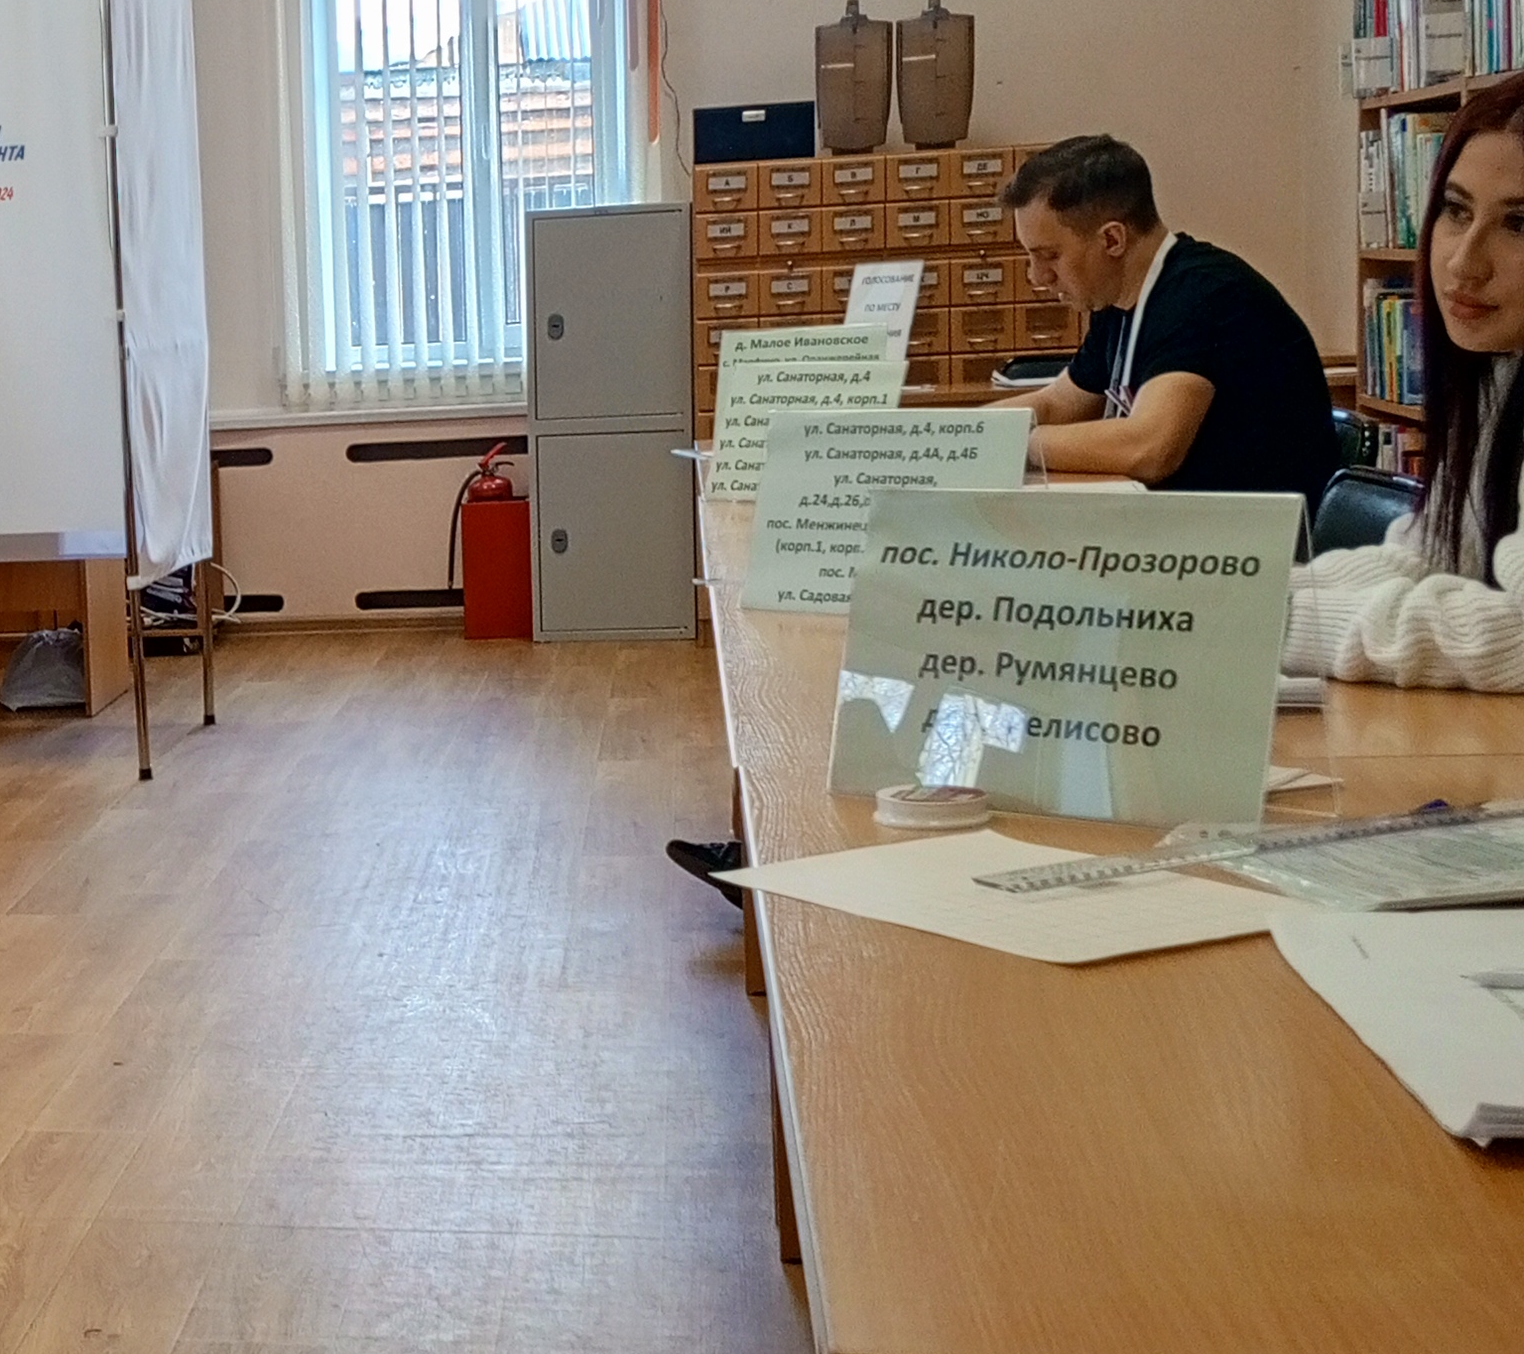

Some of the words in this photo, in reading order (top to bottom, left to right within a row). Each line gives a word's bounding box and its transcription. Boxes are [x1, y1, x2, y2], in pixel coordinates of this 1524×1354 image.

[861, 274, 915, 285] ГОЛОСОВАНИЕ
[864, 303, 876, 312] ПО
[877, 302, 901, 312] МЕСТУ
[735, 342, 747, 352] д.
[750, 339, 791, 349] Малое
[794, 336, 869, 347] Ивановское
[757, 373, 773, 385] ул.
[776, 371, 847, 384] Санаторная,
[850, 370, 871, 384] д.4
[730, 395, 746, 407] ул.
[749, 394, 818, 407] Санаторная,
[820, 394, 843, 407] д.4,
[847, 394, 888, 407] корп.1
[725, 417, 741, 429] ул.
[804, 424, 823, 437] ул.
[826, 422, 907, 437] Санаторная,
[909, 422, 935, 437] д.4,
[938, 421, 984, 437] корп.6
[720, 439, 735, 451] ул.
[804, 449, 823, 462] ул.
[826, 447, 907, 462] Санаторная,
[909, 447, 944, 462] д.4А,
[947, 447, 979, 462] д.4Б
[716, 461, 731, 473] ул.
[834, 475, 853, 487] ул.
[856, 472, 937, 487] Санаторная,
[711, 481, 727, 493] ул.
[767, 519, 792, 529] пос.
[776, 538, 826, 555] (корп.1,
[880, 544, 939, 567] пос.
[949, 542, 1261, 580] Николо-Прозорово
[819, 567, 845, 578] пос.
[777, 590, 796, 603] ул.
[916, 597, 981, 626] дер.
[992, 596, 1195, 632] Подольниха
[918, 651, 984, 681] дер.
[995, 651, 1179, 691] Румянцево
[1025, 714, 1162, 747] елисово
